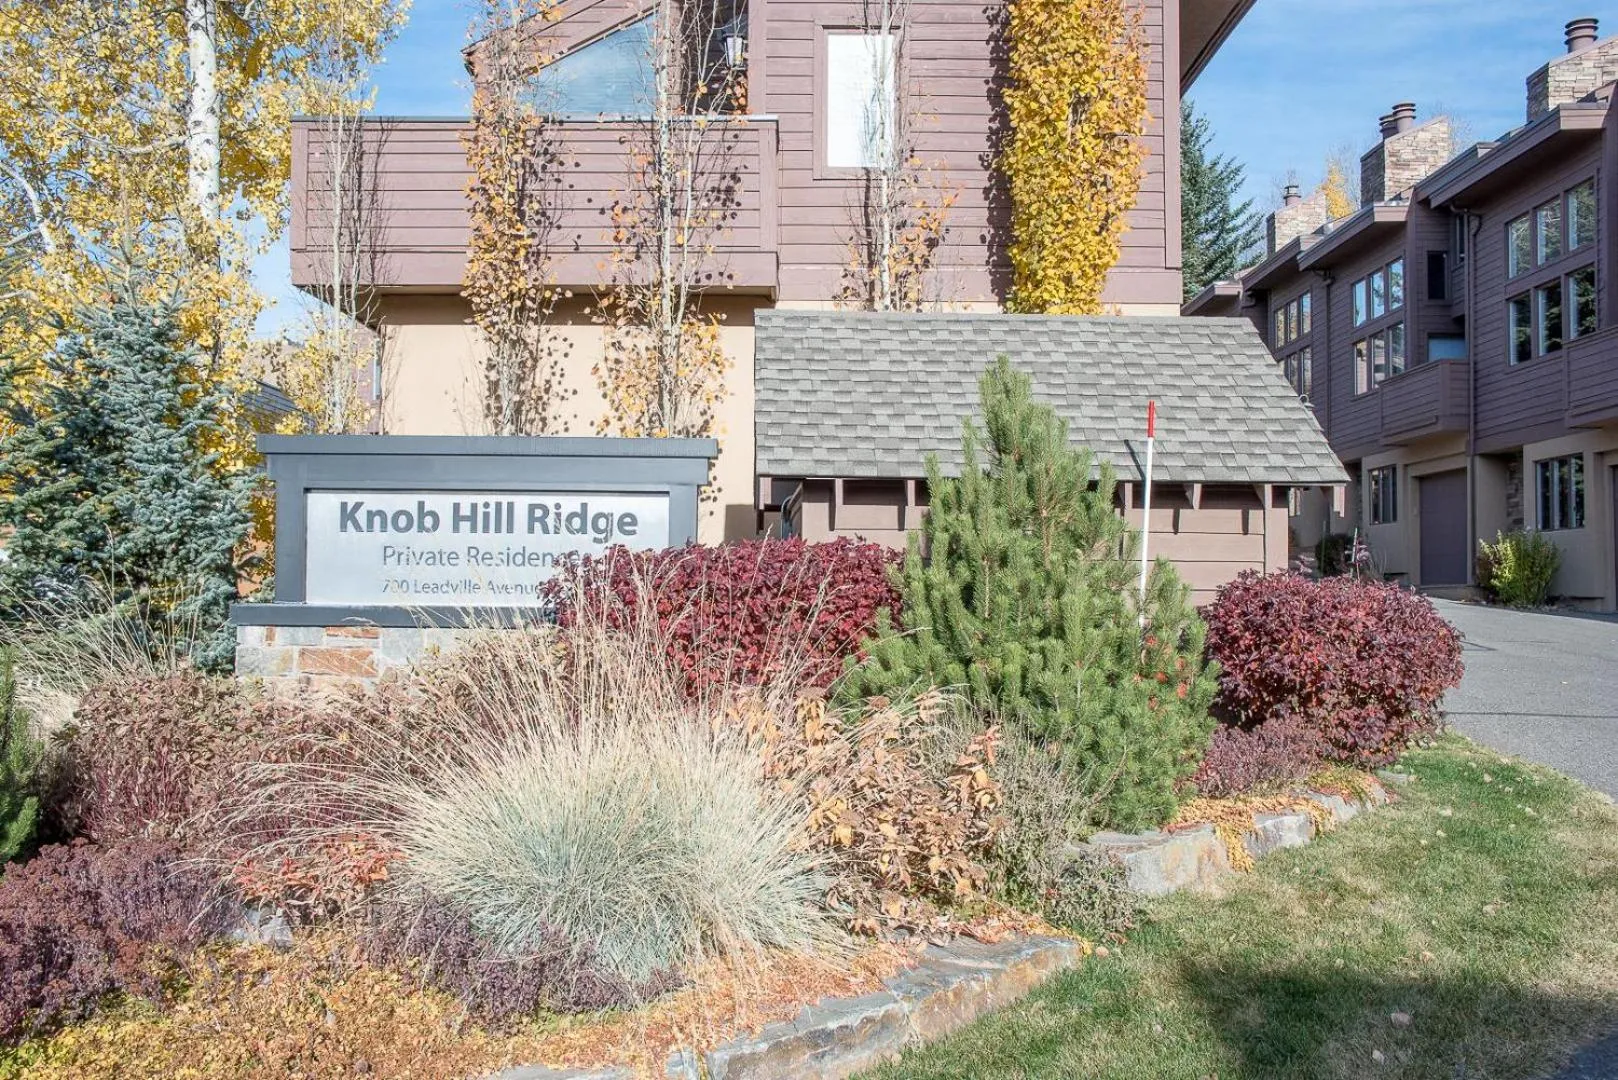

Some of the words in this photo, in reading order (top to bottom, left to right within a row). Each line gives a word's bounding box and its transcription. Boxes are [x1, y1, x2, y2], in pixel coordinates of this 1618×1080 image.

[339, 500, 440, 533] Knob
[452, 501, 514, 534] Hill
[527, 502, 638, 544] Ridge
[383, 545, 460, 566] Private
[414, 579, 481, 594] Leadville
